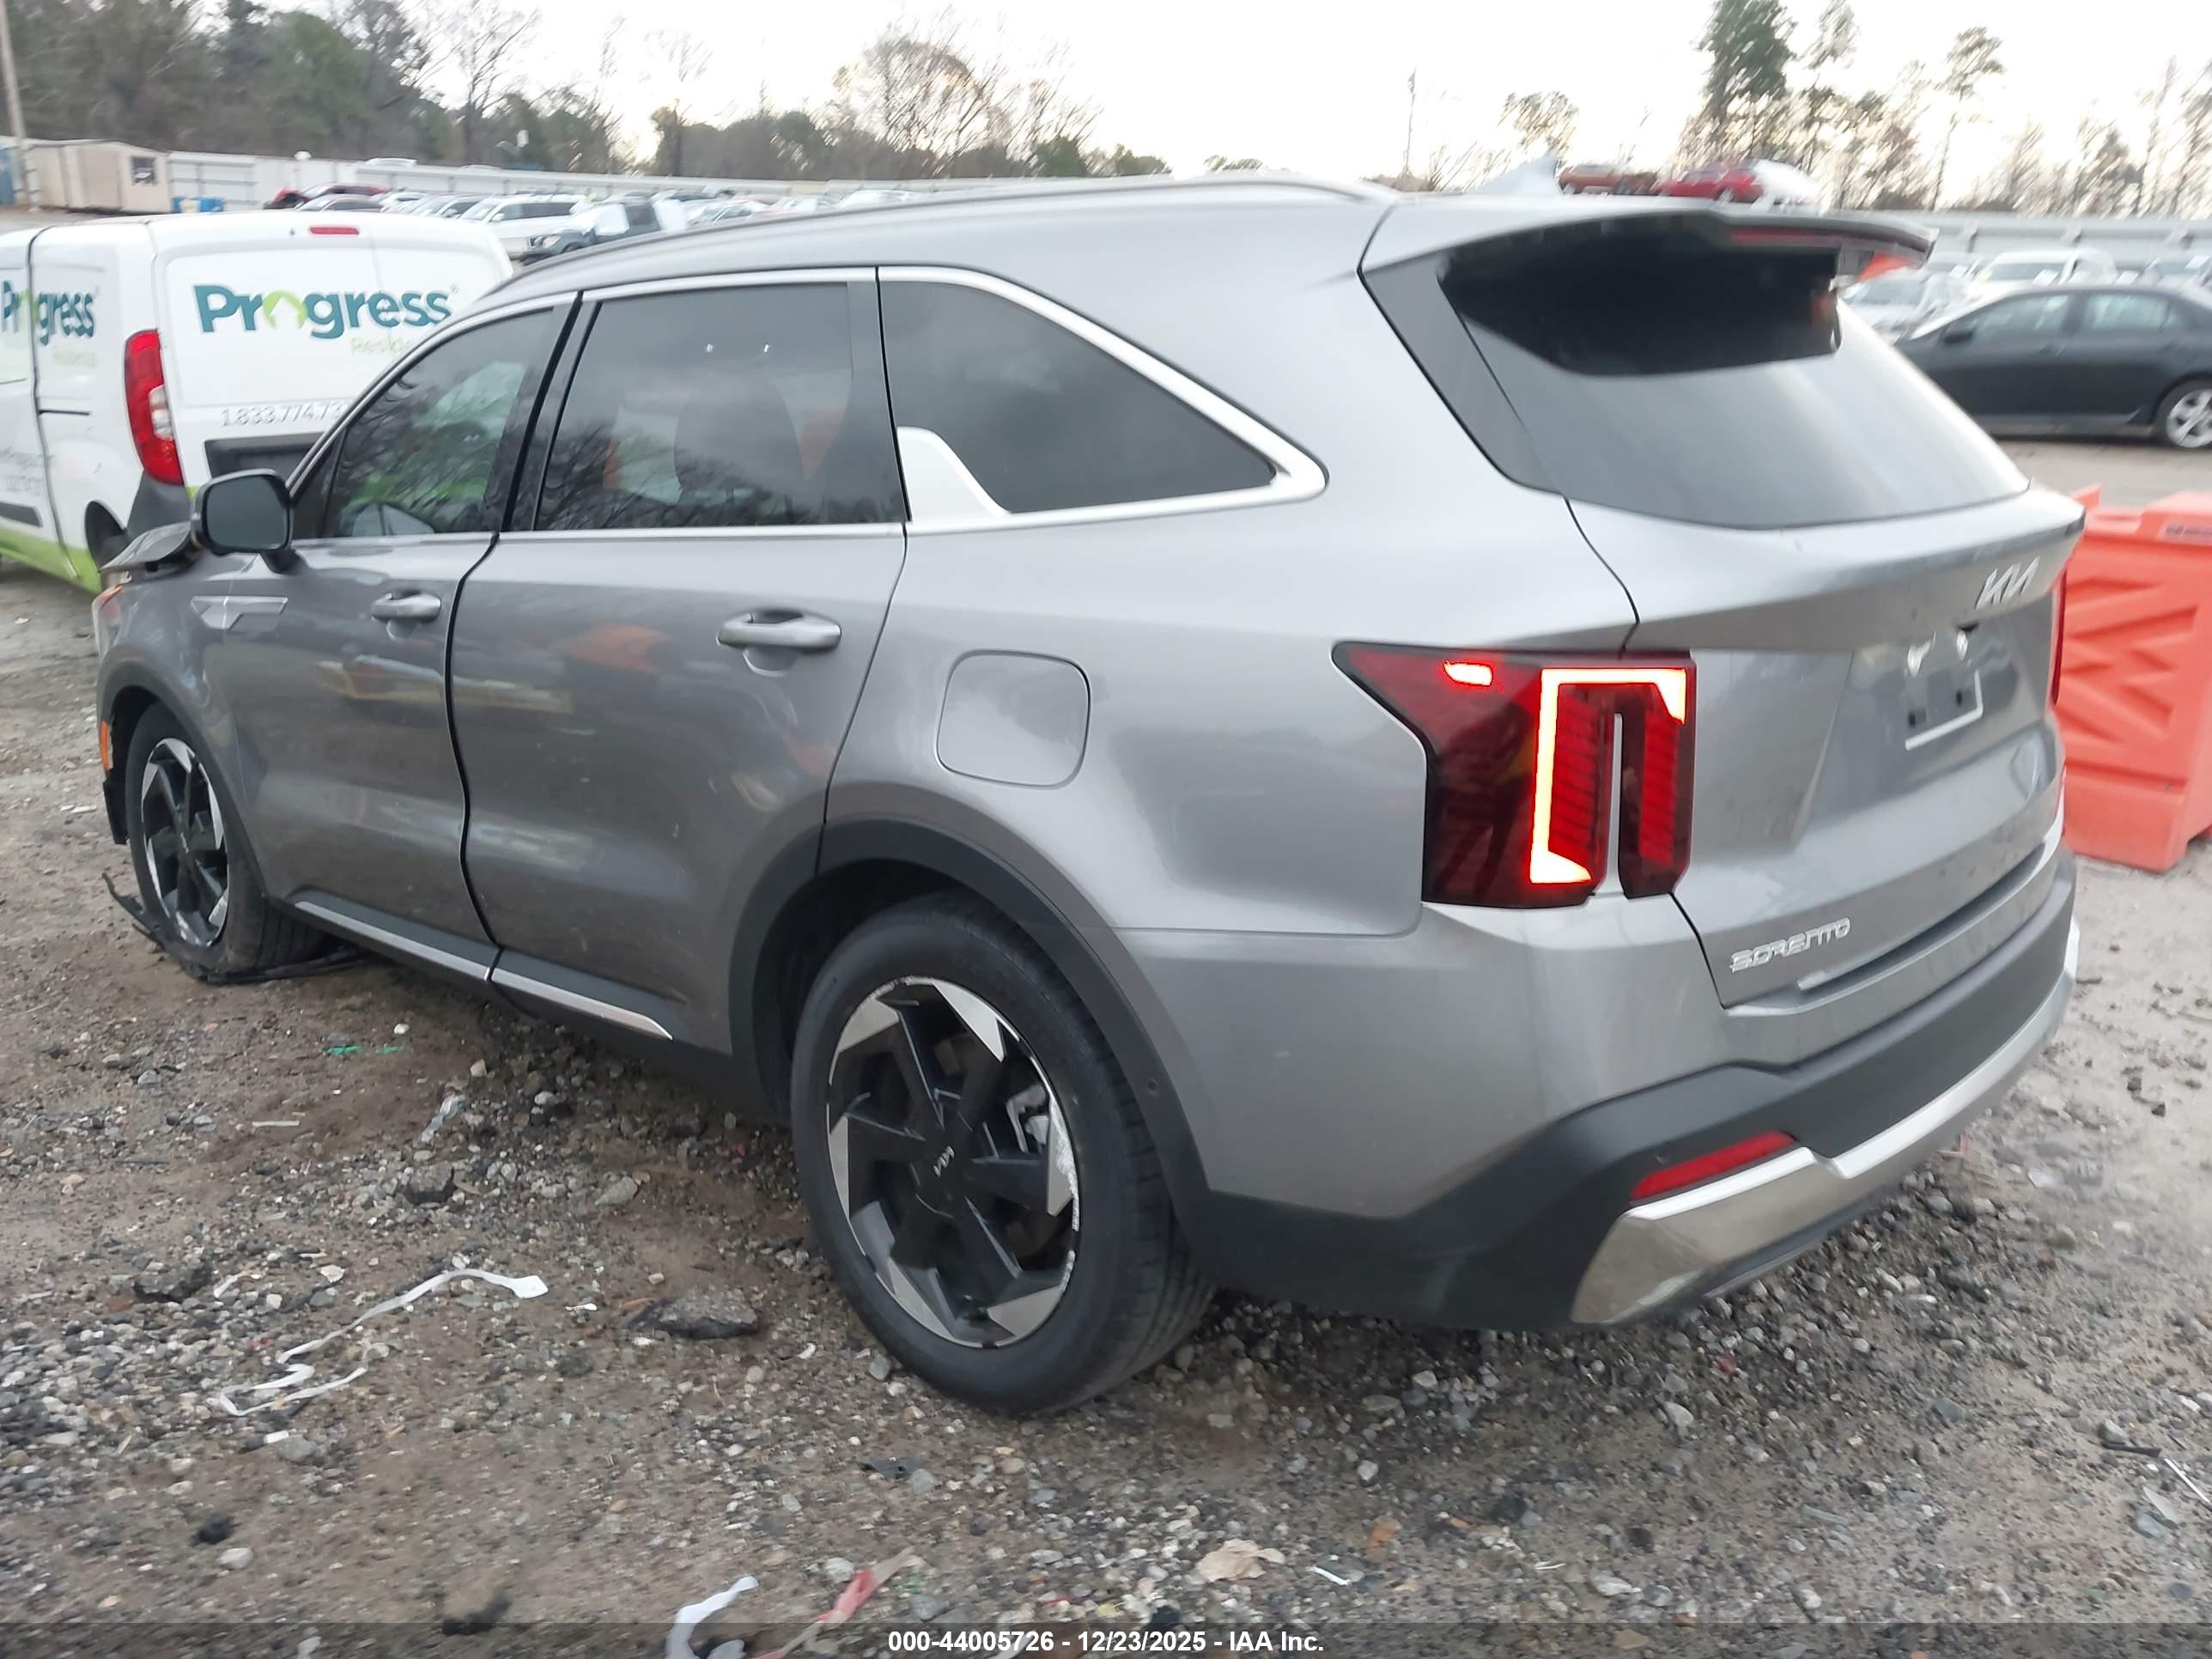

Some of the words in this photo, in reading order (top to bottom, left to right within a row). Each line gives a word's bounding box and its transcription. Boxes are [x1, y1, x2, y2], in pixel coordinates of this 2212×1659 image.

[194, 283, 452, 339] Progress
[1975, 556, 2040, 611] KIA
[1729, 917, 1851, 973] SORENTO
